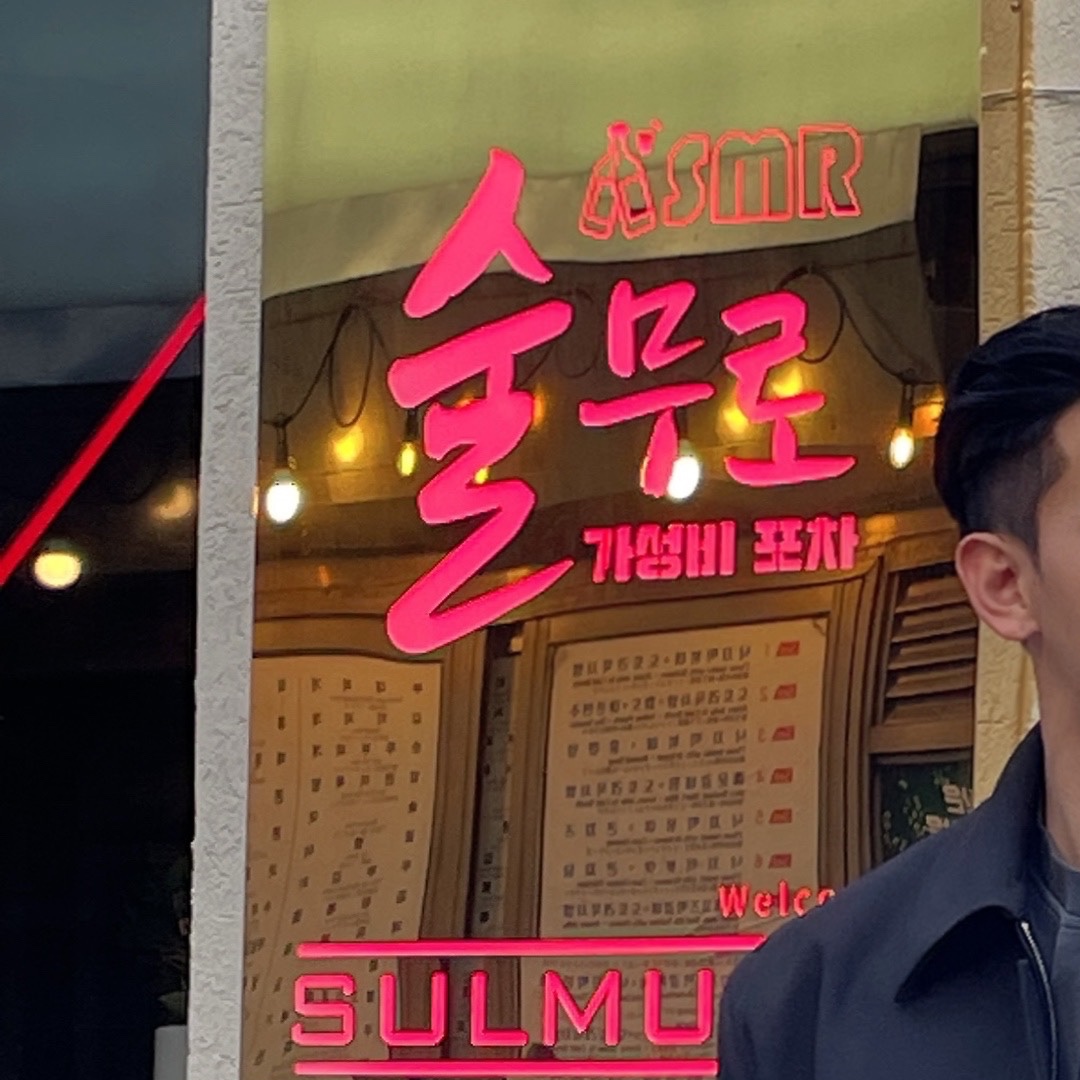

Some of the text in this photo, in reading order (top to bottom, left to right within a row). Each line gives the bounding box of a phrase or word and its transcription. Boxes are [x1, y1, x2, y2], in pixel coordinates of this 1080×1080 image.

[385, 146, 858, 655] 술무로
[583, 516, 860, 583] 가성비 포차
[290, 968, 714, 1047] SULMU
